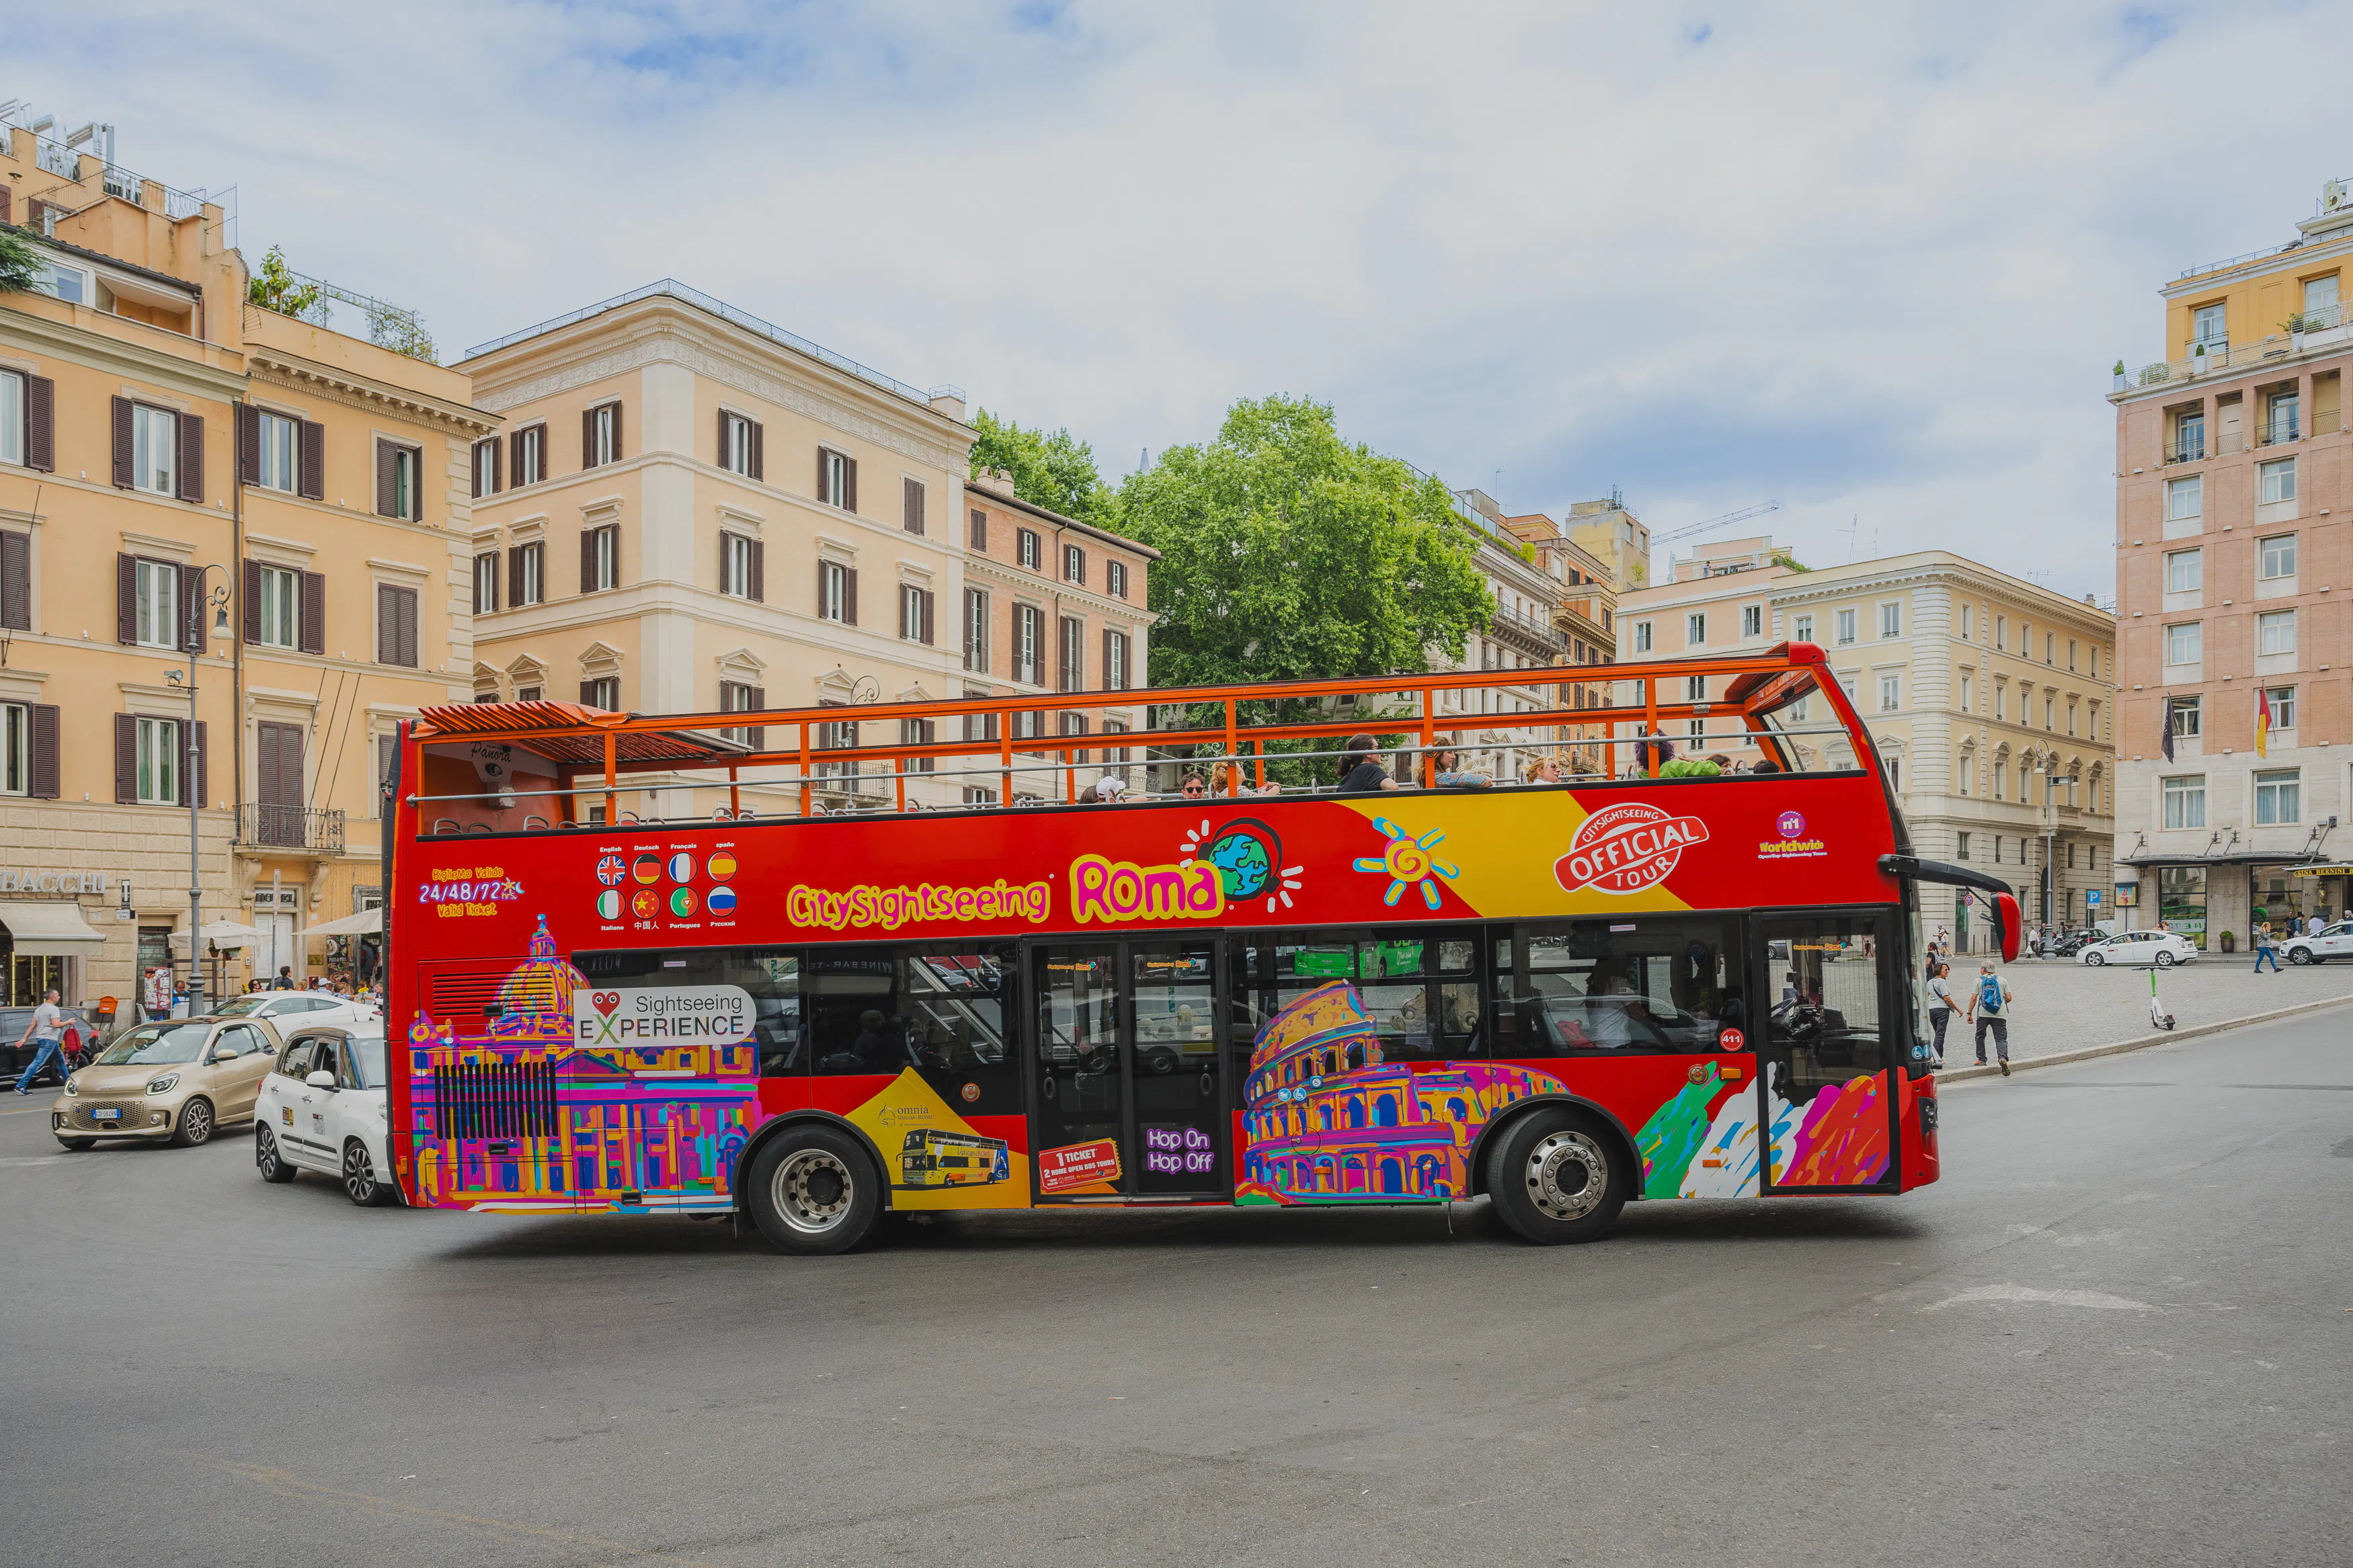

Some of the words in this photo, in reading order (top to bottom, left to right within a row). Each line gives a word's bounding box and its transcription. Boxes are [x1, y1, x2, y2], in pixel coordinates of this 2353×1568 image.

[1582, 809, 1659, 843] CITYSIGHTSEEING
[1570, 821, 1700, 880] OFFICIAL
[1759, 839, 1824, 852] Worldwide
[432, 868, 473, 882] Biglietto
[475, 866, 504, 878] Valido
[1614, 856, 1672, 887] TOUR
[256, 893, 294, 903] HOEL
[419, 880, 502, 903] 24/48/72
[1070, 854, 1224, 923] Roma
[437, 903, 464, 918] Valid
[465, 902, 497, 916] Ticket
[634, 921, 660, 930] 中国人
[636, 994, 742, 1016] Sightseeing
[580, 1014, 744, 1044] EXPERIENCE
[1722, 1035, 1740, 1043] 411
[898, 1105, 928, 1114] omnia
[1148, 1129, 1182, 1150] Hop
[1185, 1128, 1209, 1149] On
[1043, 1169, 1051, 1178] 2
[1051, 1167, 1067, 1175] ROME
[1068, 1165, 1084, 1173] OPEN
[1096, 1159, 1115, 1167] TOURS
[1055, 1153, 1064, 1167] 1
[1148, 1152, 1183, 1173] Hop
[1185, 1151, 1213, 1171] Off
